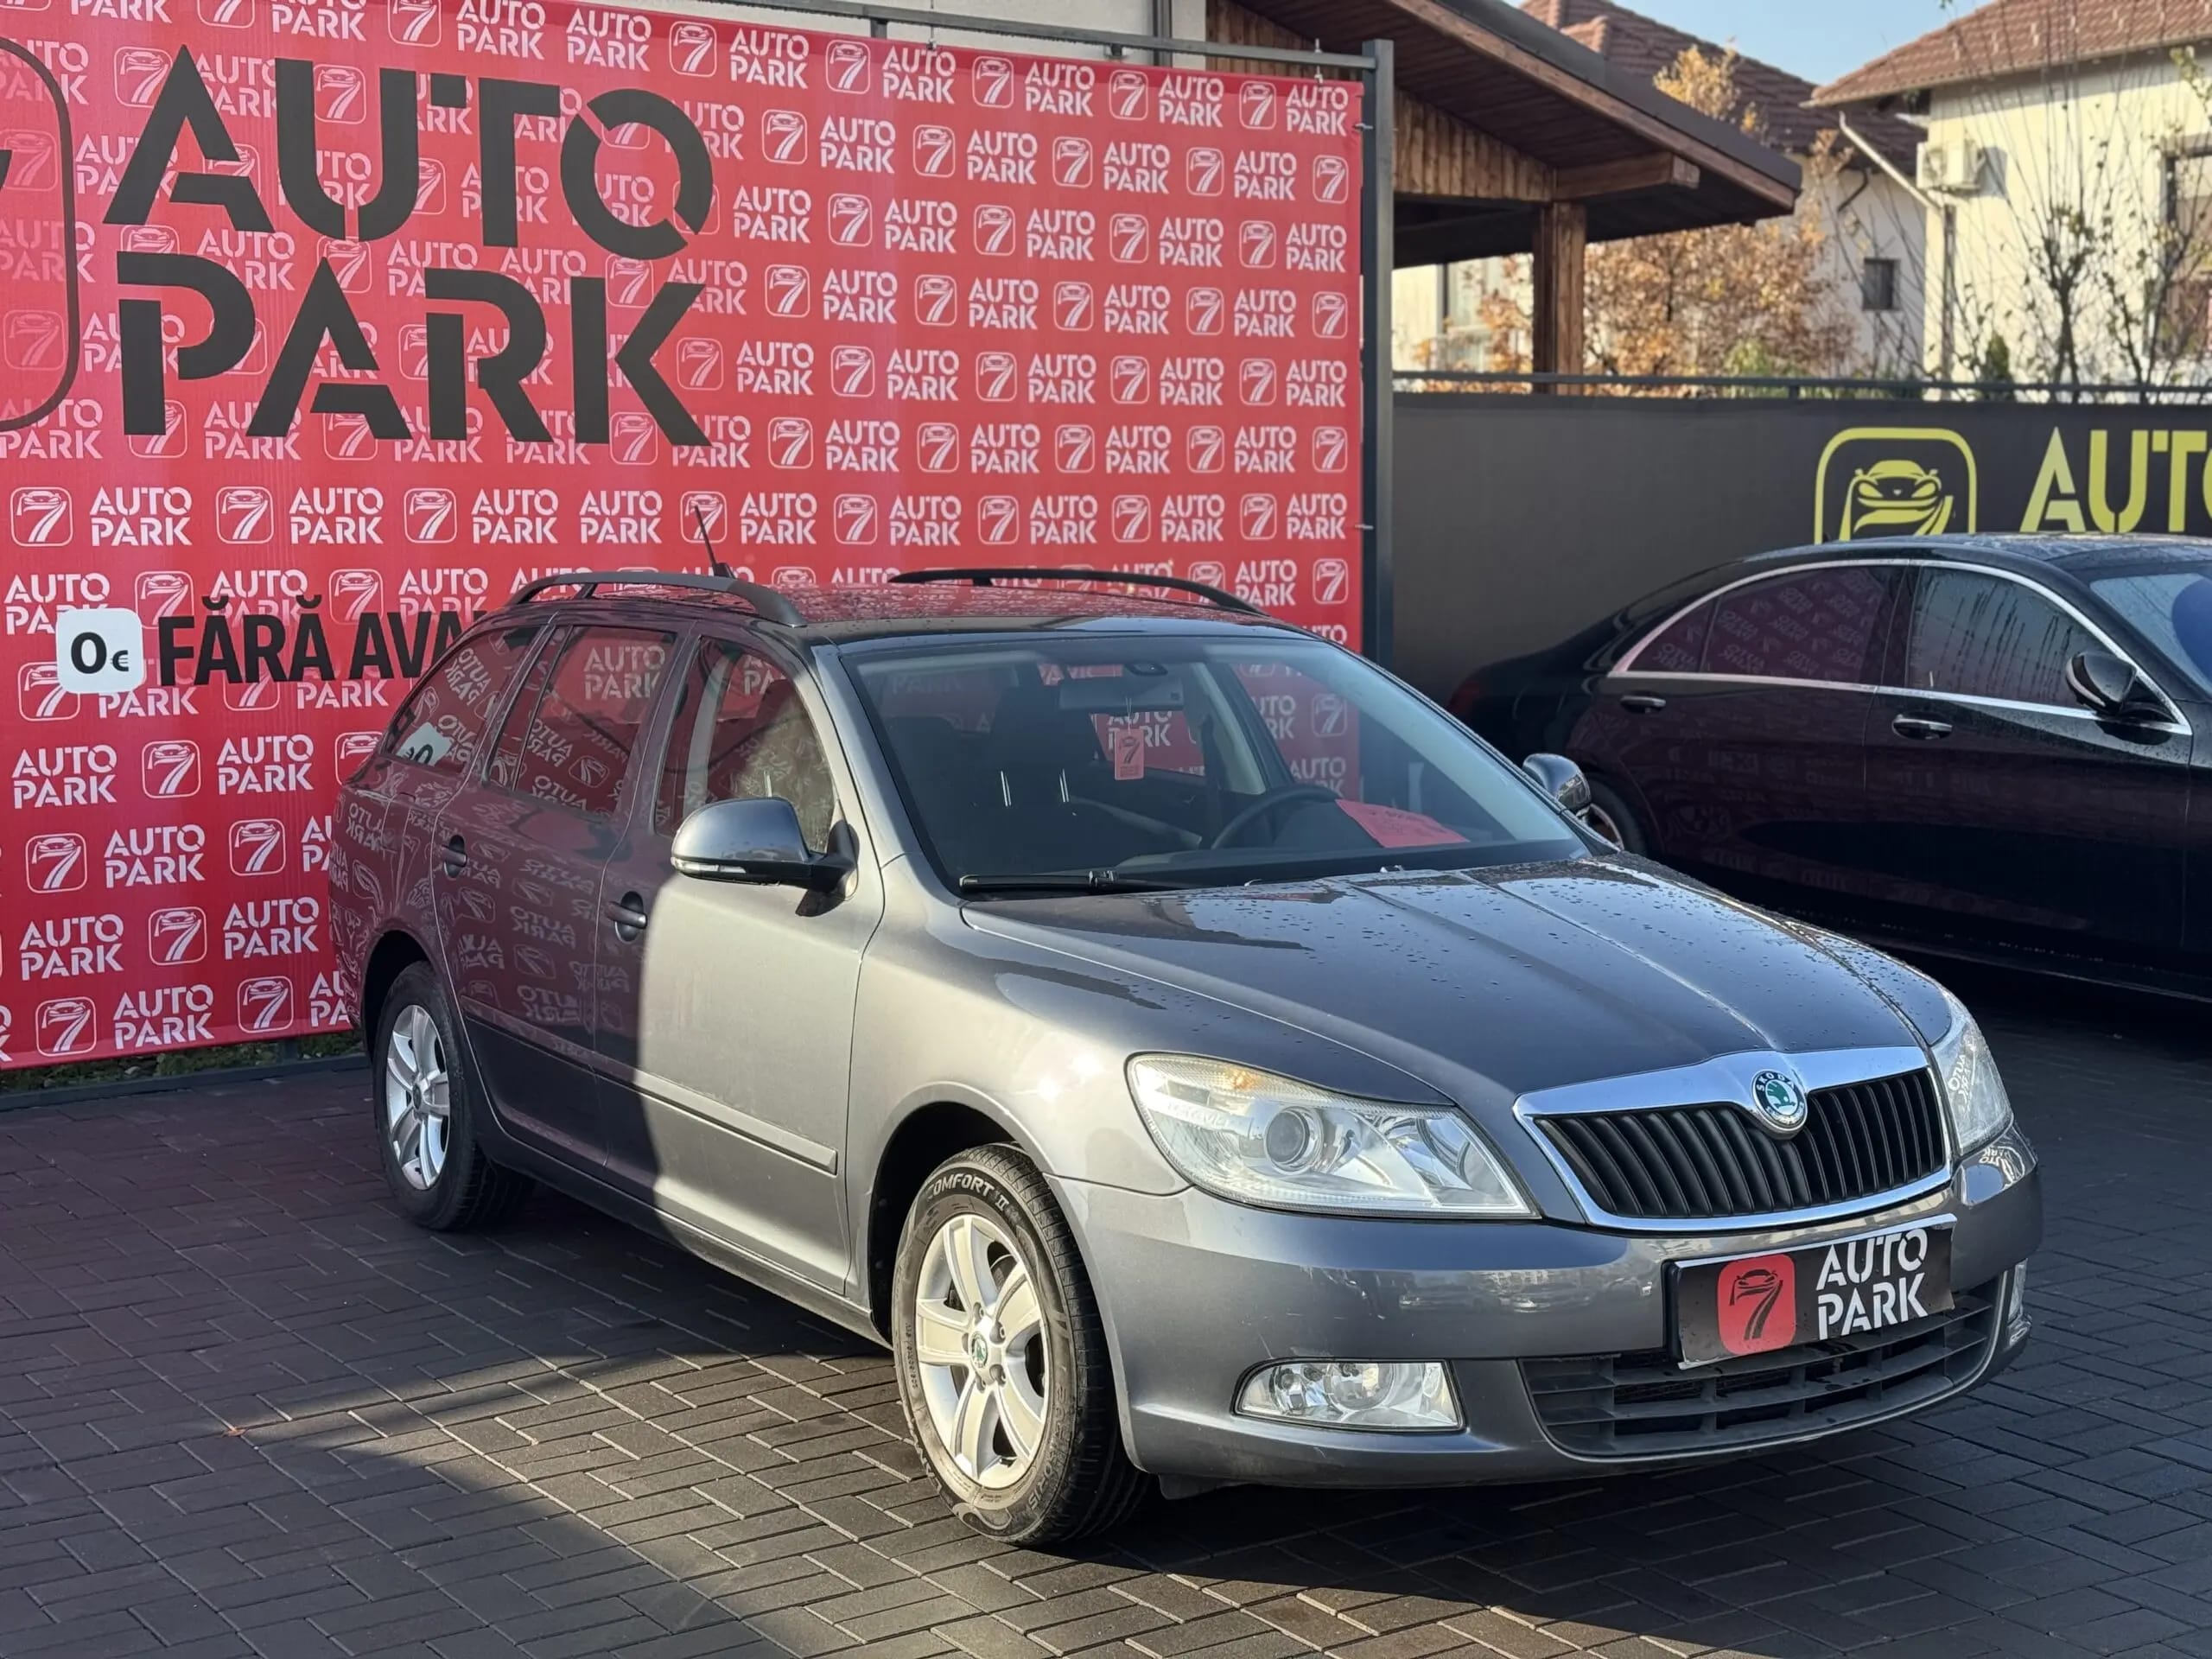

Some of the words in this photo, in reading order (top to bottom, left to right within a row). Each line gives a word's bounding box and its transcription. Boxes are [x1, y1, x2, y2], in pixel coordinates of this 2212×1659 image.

[271, 4, 366, 41] PARK
[456, 0, 545, 29] AUTO
[567, 10, 652, 41] AUTO
[458, 23, 543, 60] PARK
[568, 36, 650, 71] PARK
[730, 28, 810, 60] AUTO
[731, 55, 807, 88] PARK
[883, 46, 956, 76] AUTO
[884, 73, 954, 103] PARK
[1026, 62, 1096, 91] AUTO
[1159, 76, 1224, 103] AUTO
[1026, 86, 1092, 116] PARK
[1286, 86, 1348, 110] AUTO
[683, 100, 744, 131] UTO
[1160, 99, 1222, 127] PARK
[1287, 109, 1345, 136] PARK
[820, 117, 895, 146] AUTO
[967, 130, 1037, 157] AUTO
[103, 44, 714, 259] AUTO
[822, 143, 894, 173] PARK
[1104, 143, 1170, 168] AUTO
[1235, 151, 1296, 175] AUTO
[968, 156, 1036, 184] PARK
[1104, 166, 1168, 194] PARK
[733, 187, 810, 215] AUTO
[1235, 175, 1294, 200] PARK
[885, 200, 957, 226] AUTO
[1027, 209, 1095, 235] AUTO
[734, 213, 810, 243] PARK
[886, 225, 956, 252] PARK
[1160, 218, 1224, 242] AUTO
[1286, 224, 1346, 247] AUTO
[197, 228, 295, 259] AUTO
[387, 240, 477, 270] AUTO
[1027, 233, 1093, 261] PARK
[1160, 242, 1222, 266] PARK
[500, 248, 586, 276] AUTO
[668, 258, 747, 287] AUTO
[1287, 247, 1344, 272] PARK
[389, 269, 425, 296] PA
[823, 270, 897, 296] AUTO
[969, 278, 1038, 303] AUTO
[824, 295, 896, 323] PARK
[1104, 285, 1170, 309] AUTO
[1235, 290, 1296, 313] AUTO
[969, 303, 1037, 329] PARK
[1105, 309, 1168, 334] PARK
[1235, 314, 1294, 337] PARK
[117, 251, 714, 447] PARK
[737, 341, 813, 368] AUTO
[887, 350, 959, 374] AUTO
[1028, 354, 1096, 378] AUTO
[1160, 359, 1224, 381] AUTO
[1287, 360, 1346, 383] AUTO
[738, 368, 812, 395] PARK
[888, 374, 957, 400] PARK
[1029, 378, 1095, 403] PARK
[1161, 382, 1222, 404] PARK
[1287, 384, 1344, 406] PARK
[0, 430, 102, 458] PARK
[206, 431, 301, 460] PARK
[826, 421, 899, 445] AUTO
[971, 424, 1039, 448] AUTO
[1106, 426, 1171, 448] AUTO
[1235, 427, 1296, 448] AUTO
[395, 435, 482, 462] PARK
[673, 442, 749, 467] PARK
[827, 446, 899, 471] PARK
[972, 449, 1039, 473] PARK
[1107, 450, 1169, 473] PARK
[1236, 450, 1294, 472] PARK
[2019, 426, 2212, 534] AUT
[90, 487, 191, 515] AUTO
[289, 488, 383, 514] AUTO
[472, 489, 558, 515] AUTO
[580, 491, 662, 516] AUTO
[740, 493, 817, 518] AUTO
[890, 496, 961, 519] AUTO
[1030, 495, 1097, 518] AUTO
[1161, 495, 1224, 517] AUTO
[1287, 493, 1346, 515] AUTO
[92, 518, 191, 546] PARK
[291, 517, 382, 543] PARK
[474, 518, 557, 543] PARK
[581, 518, 661, 543] PARK
[741, 519, 816, 543] PARK
[891, 522, 959, 545] PARK
[1031, 520, 1096, 543] PARK
[1162, 518, 1223, 541] PARK
[1287, 515, 1344, 539] PARK
[210, 569, 308, 598] AUTO
[398, 568, 488, 595] AUTO
[1236, 560, 1296, 582] AUTO
[4, 573, 111, 604] AUTO
[1236, 583, 1294, 606] PARK
[159, 594, 336, 686] FĂRĂ
[348, 612, 487, 680] AVA
[583, 645, 665, 672] AUTO
[99, 686, 199, 719] PARK
[297, 679, 389, 709] PARK
[12, 745, 117, 778] AUTO
[217, 734, 313, 765] AUTO
[14, 775, 116, 809] PARK
[219, 764, 313, 794] PARK
[105, 825, 205, 857] AUTO
[106, 854, 204, 887] PARK
[223, 897, 319, 930] AUTO
[20, 914, 124, 950] AUTO
[226, 925, 318, 959] PARK
[22, 944, 123, 980] PARK
[114, 985, 213, 1020] AUTO
[116, 1014, 214, 1049] PARK
[926, 1173, 995, 1201] COMFORT
[1815, 1228, 1928, 1291] AUTO
[1817, 1272, 1928, 1340] PARK
